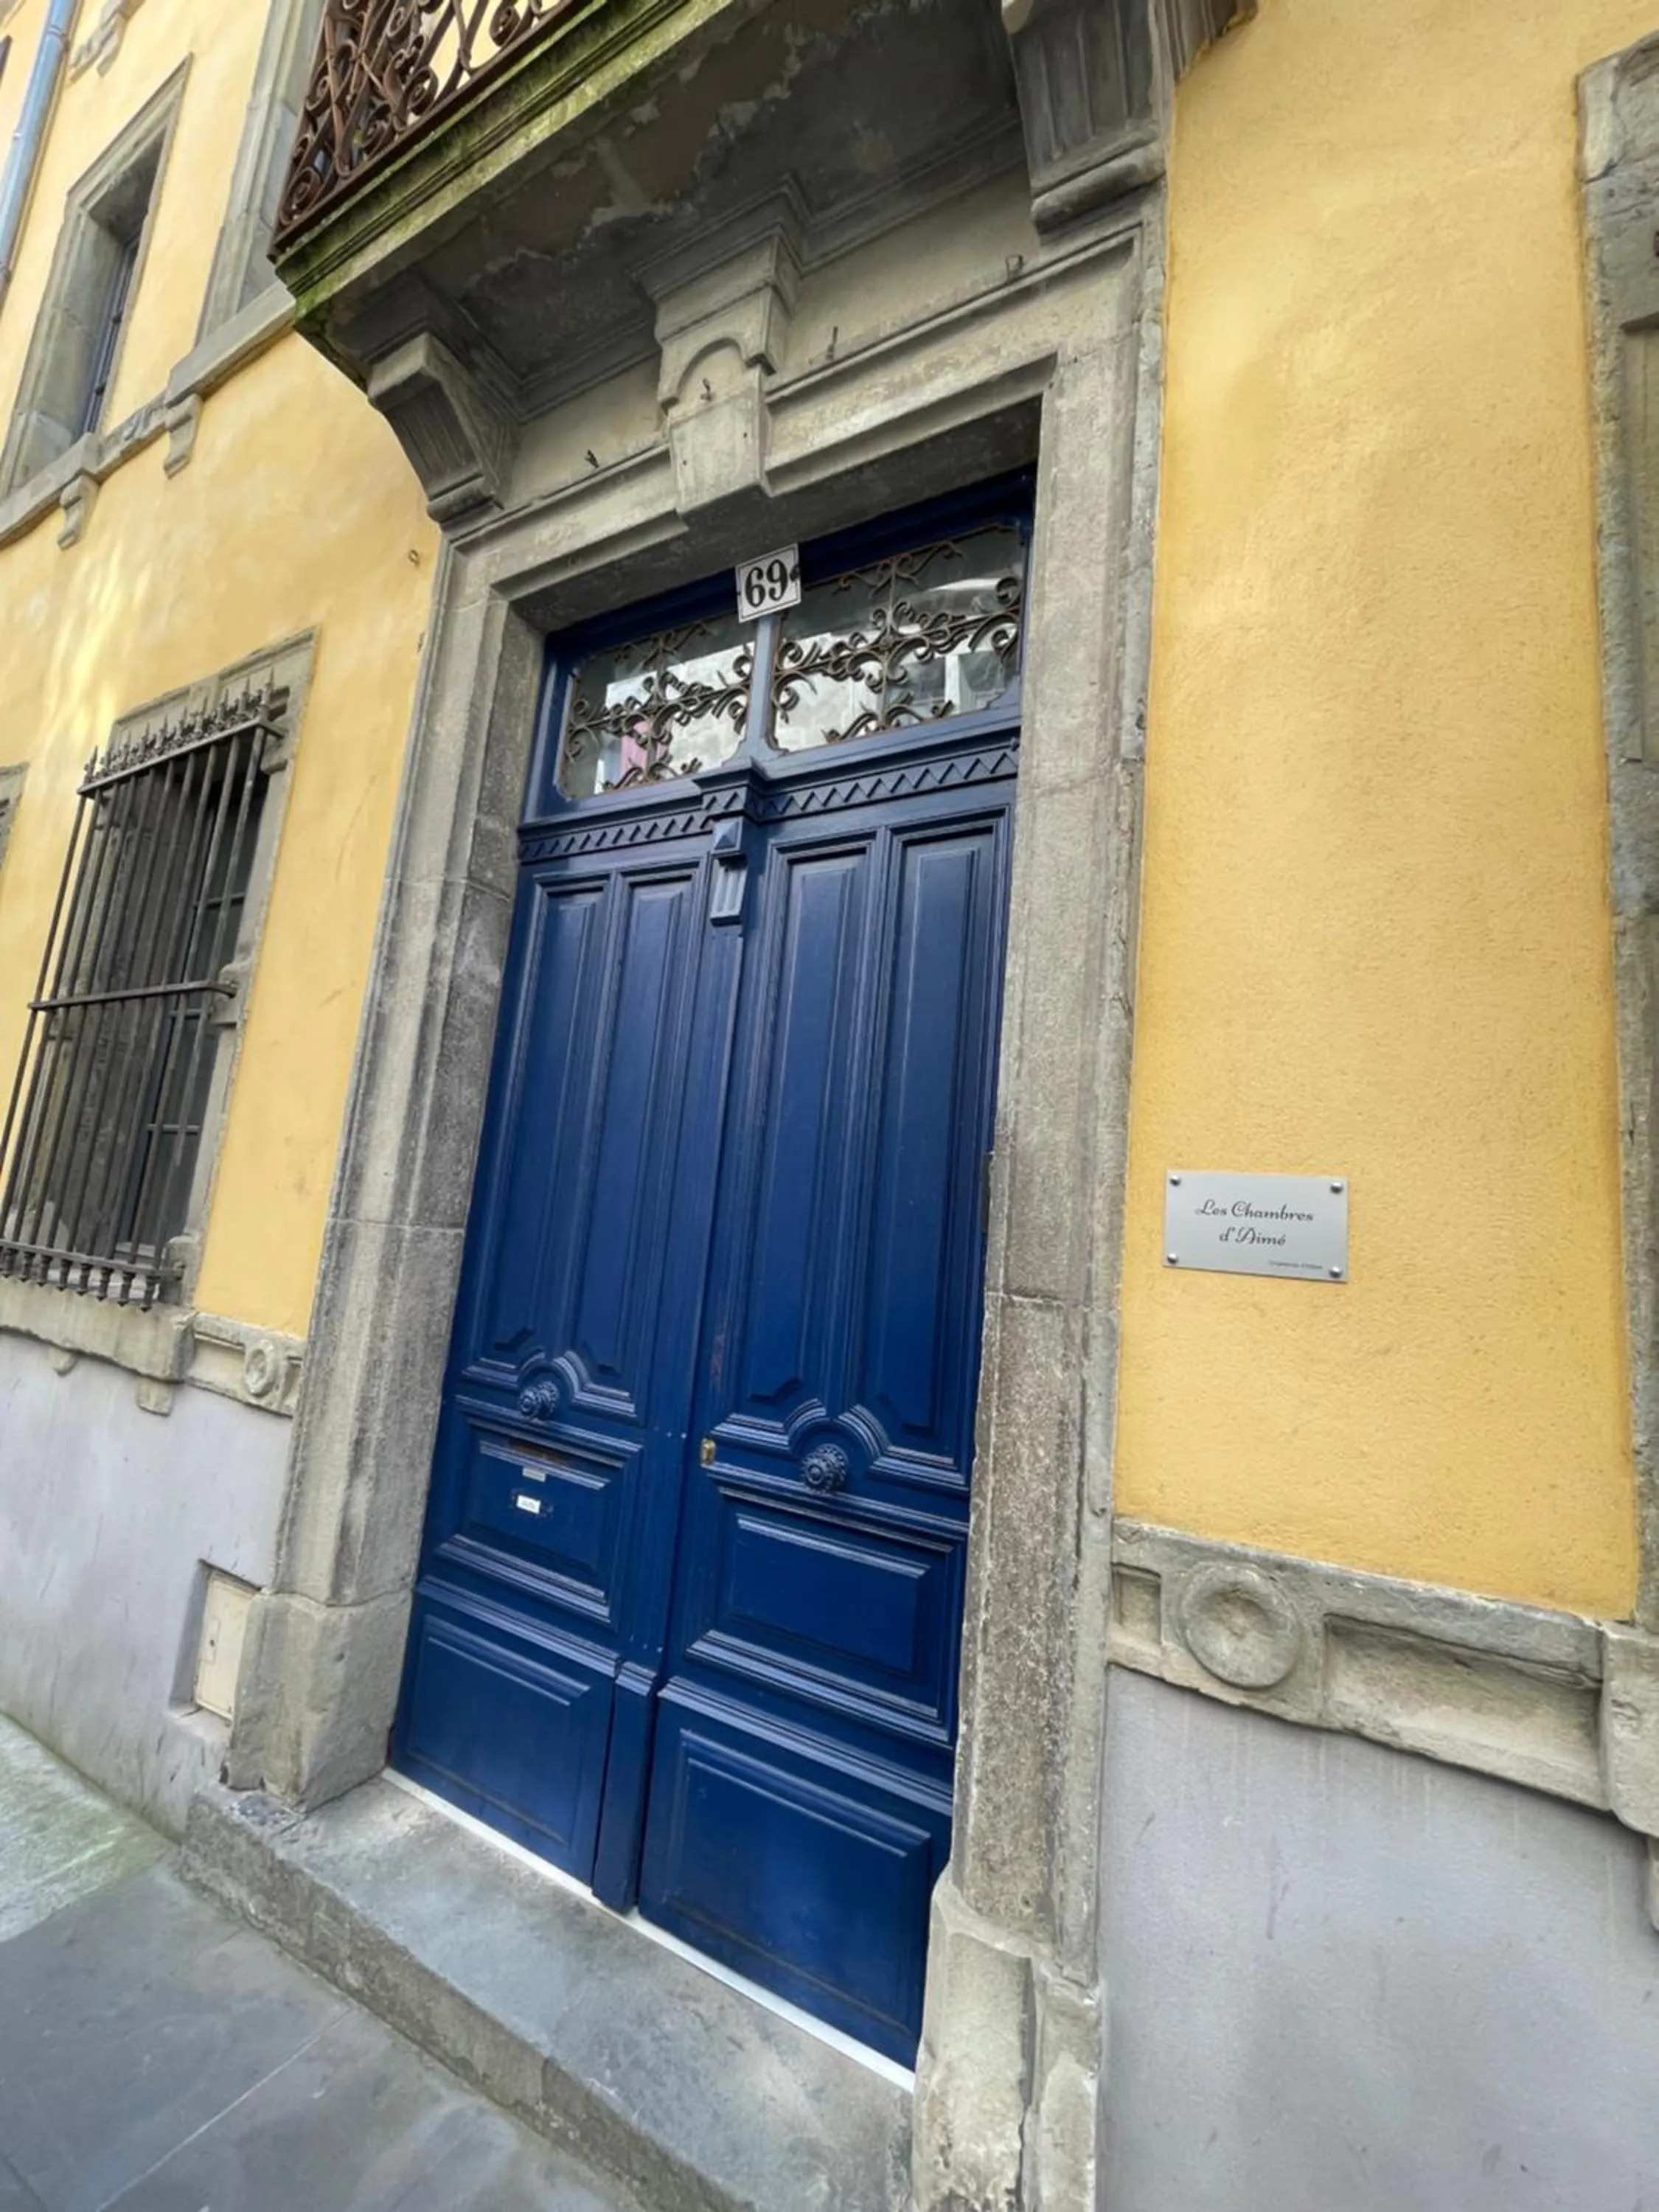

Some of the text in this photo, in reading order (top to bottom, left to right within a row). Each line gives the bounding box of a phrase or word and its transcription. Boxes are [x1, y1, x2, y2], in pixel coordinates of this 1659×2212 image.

[745, 559, 788, 608] 69
[1194, 1199, 1313, 1221] Les Chambres
[1219, 1227, 1286, 1246] d'Aimé
